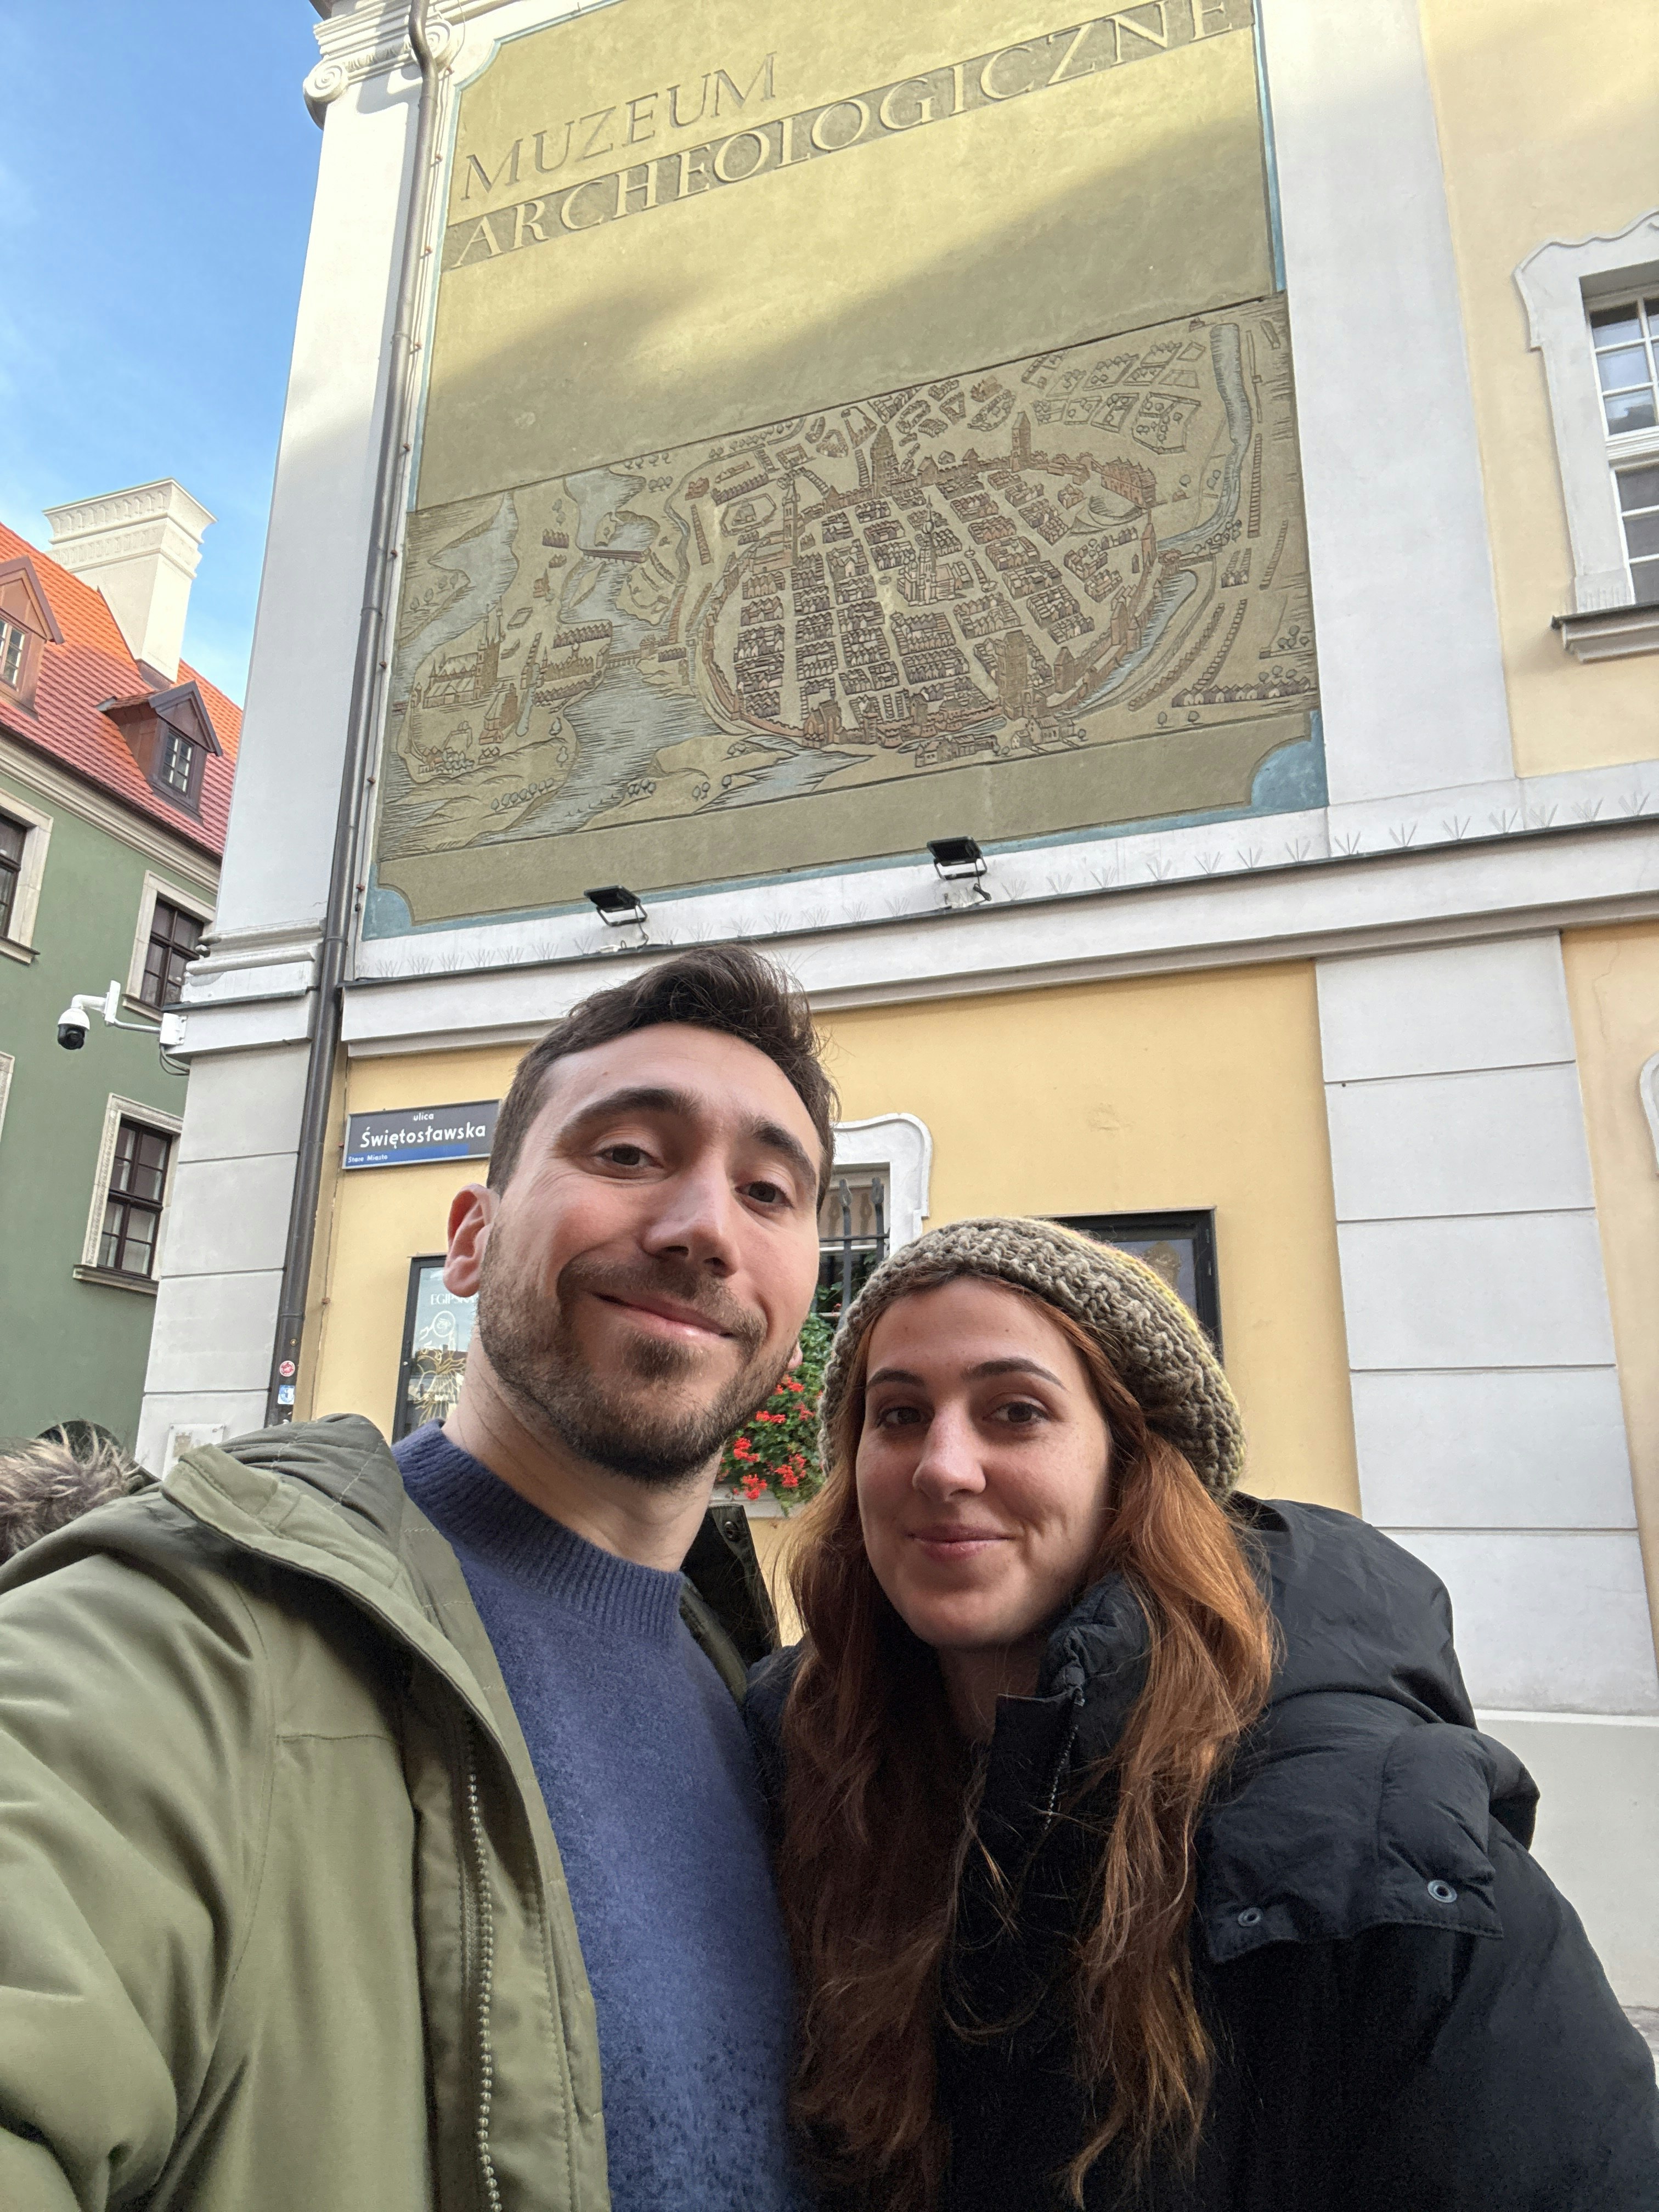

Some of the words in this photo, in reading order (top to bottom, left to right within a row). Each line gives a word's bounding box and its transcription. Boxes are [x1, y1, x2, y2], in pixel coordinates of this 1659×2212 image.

[450, 0, 1233, 269] ARCHEOLOGICZNE
[461, 51, 777, 201] MUZEUM
[360, 1122, 486, 1149] Świętosławska
[413, 1112, 434, 1121] ulica
